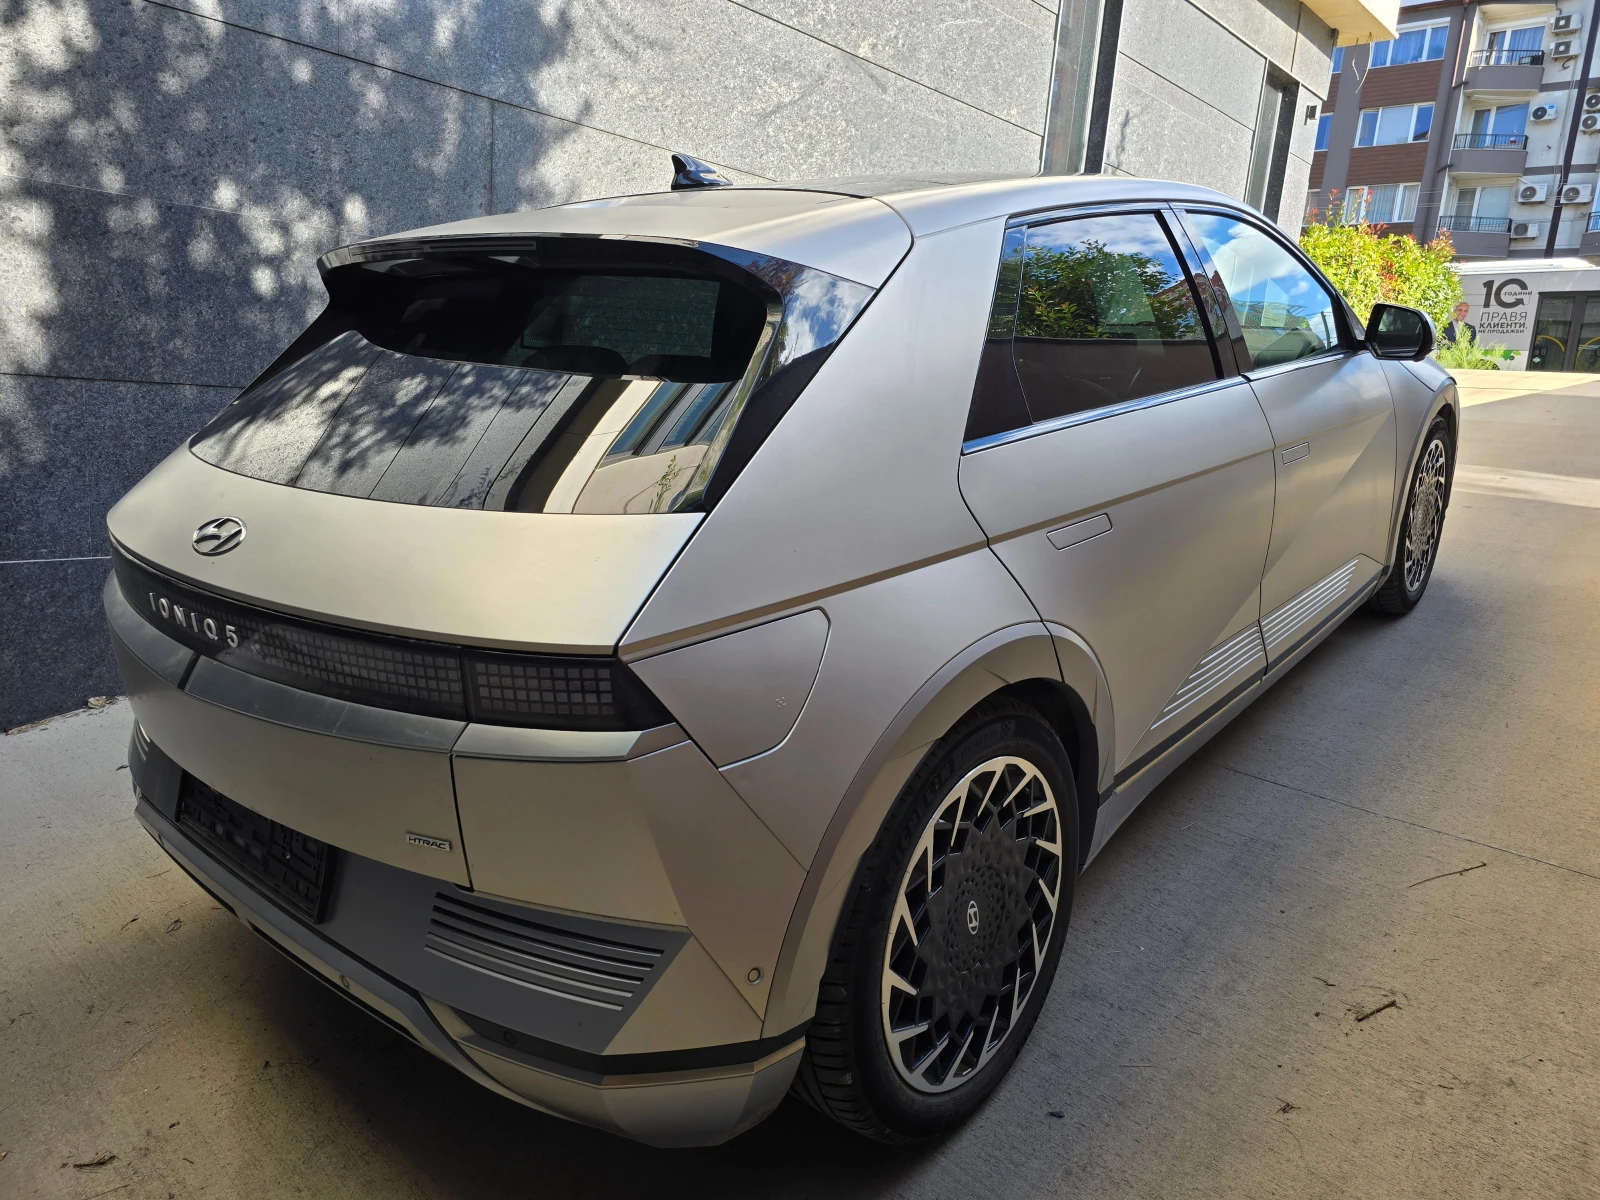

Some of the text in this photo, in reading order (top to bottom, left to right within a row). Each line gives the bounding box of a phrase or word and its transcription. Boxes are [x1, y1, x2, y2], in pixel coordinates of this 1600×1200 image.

[1480, 312, 1527, 321] ПРАВЯ
[149, 592, 239, 648] IONIQ 5
[884, 762, 951, 887] MICHELIN
[408, 836, 447, 850] HTRAC
